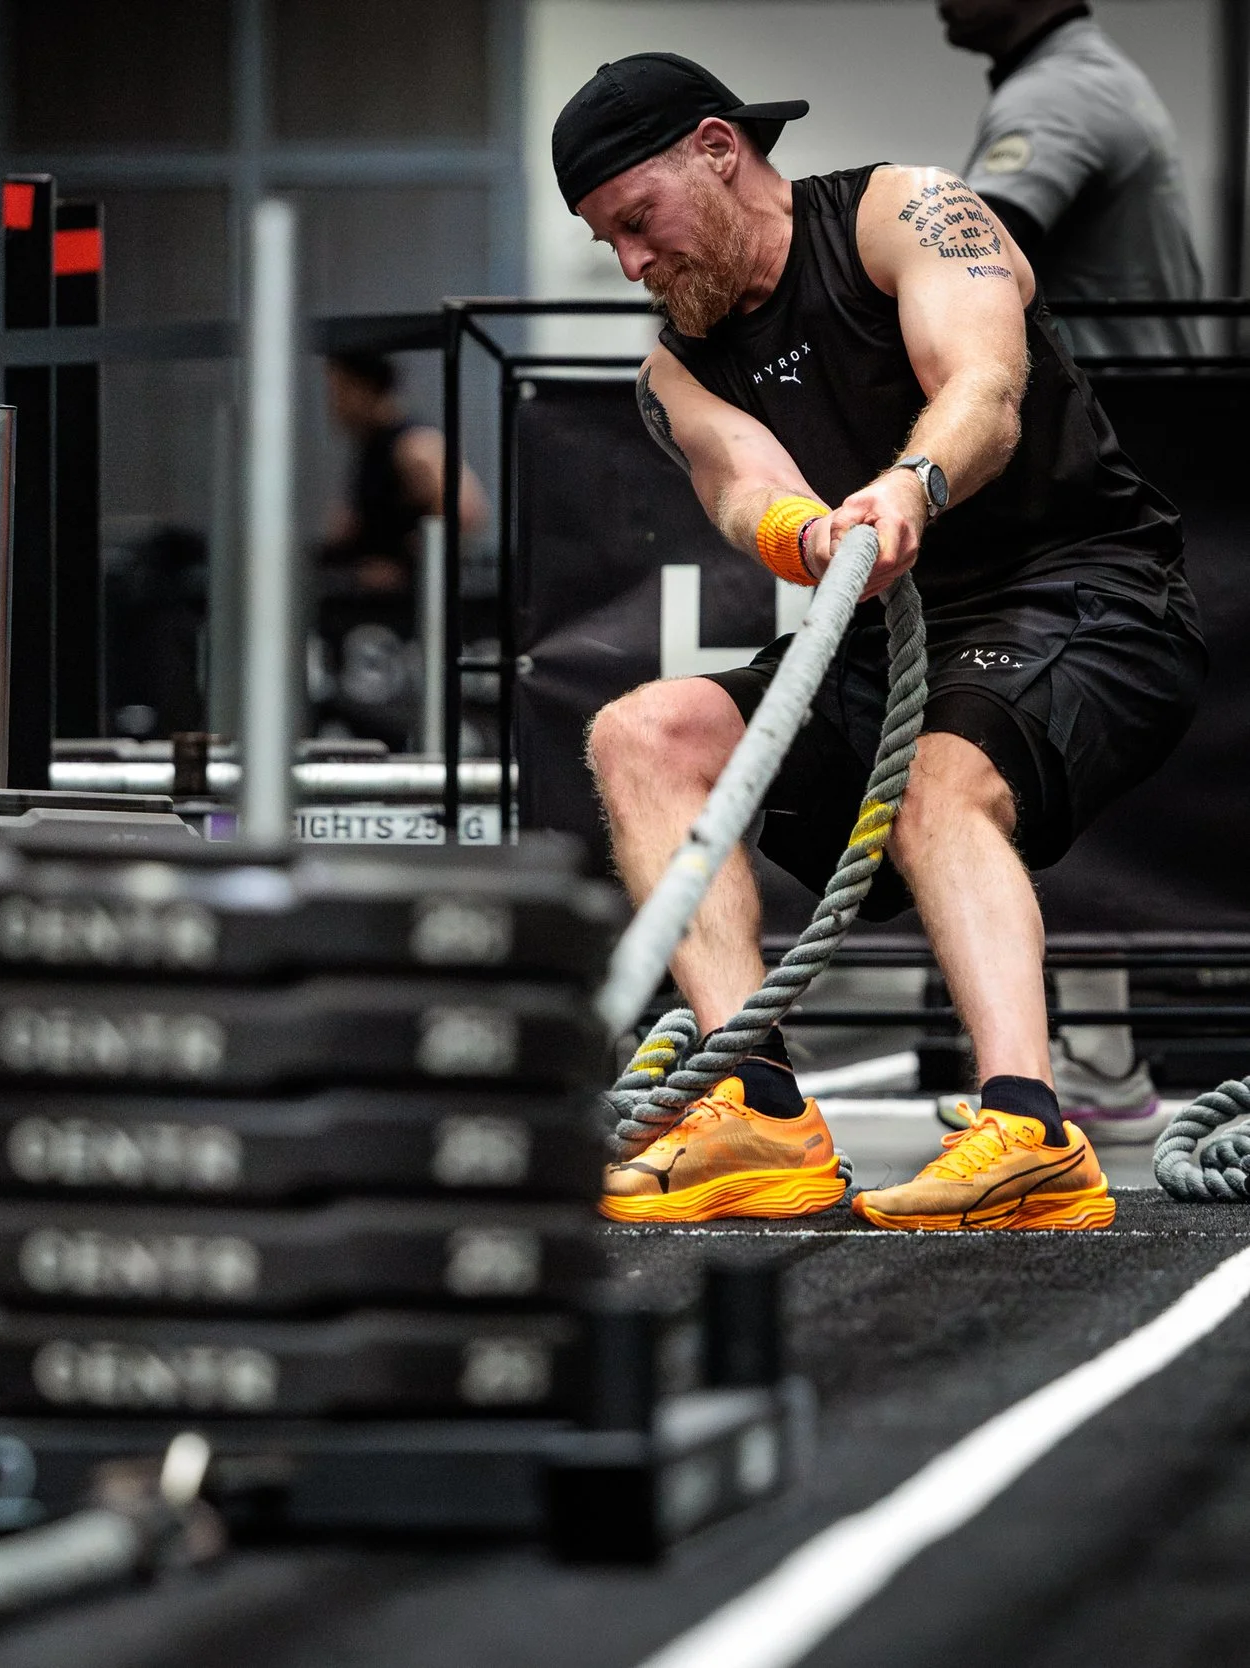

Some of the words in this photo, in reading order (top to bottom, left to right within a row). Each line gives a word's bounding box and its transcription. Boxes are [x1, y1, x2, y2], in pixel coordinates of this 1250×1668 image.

[898, 200, 922, 222] All
[921, 184, 944, 199] the
[915, 217, 929, 232] all
[926, 202, 945, 216] the
[930, 222, 946, 240] all
[944, 211, 964, 225] the
[960, 226, 981, 239] are
[938, 243, 991, 259] within
[753, 342, 810, 384] HYROX
[960, 649, 1023, 669] HYROX
[294, 814, 394, 840] IGHTS
